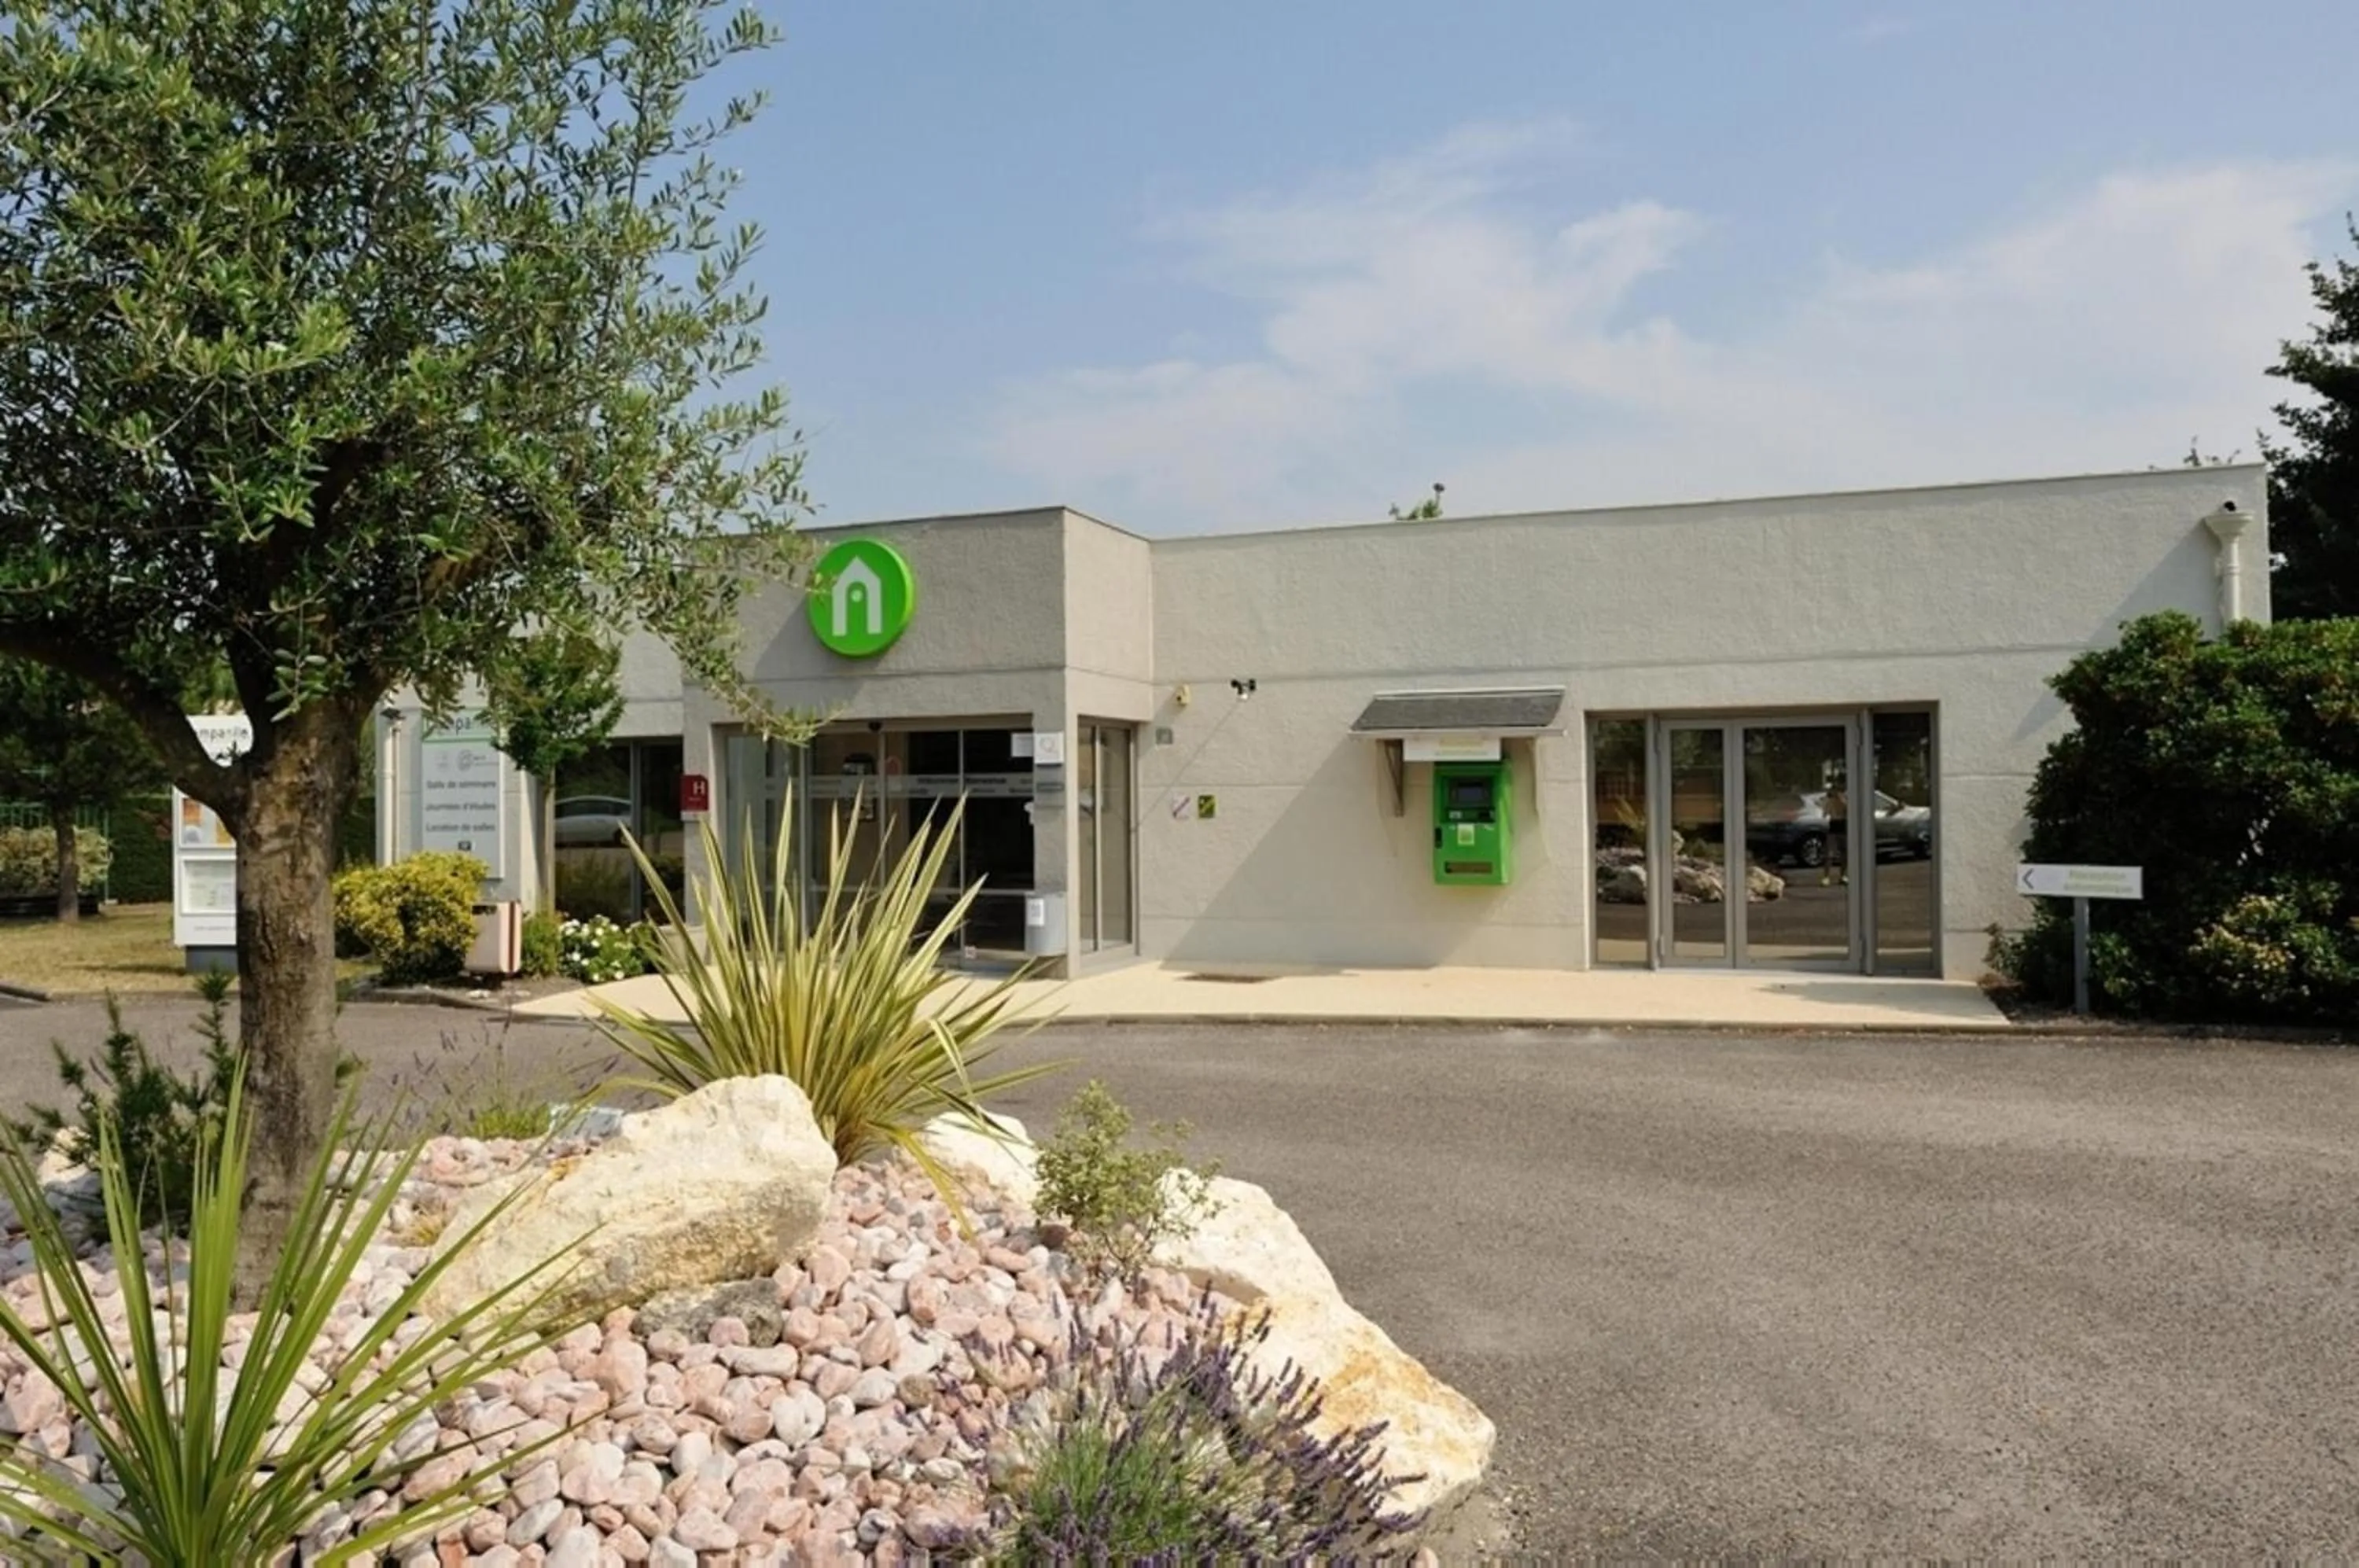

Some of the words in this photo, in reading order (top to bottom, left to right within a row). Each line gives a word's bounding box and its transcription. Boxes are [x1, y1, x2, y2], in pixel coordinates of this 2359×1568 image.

[447, 780, 456, 789] de
[693, 781, 705, 796] H
[461, 822, 470, 831] de
